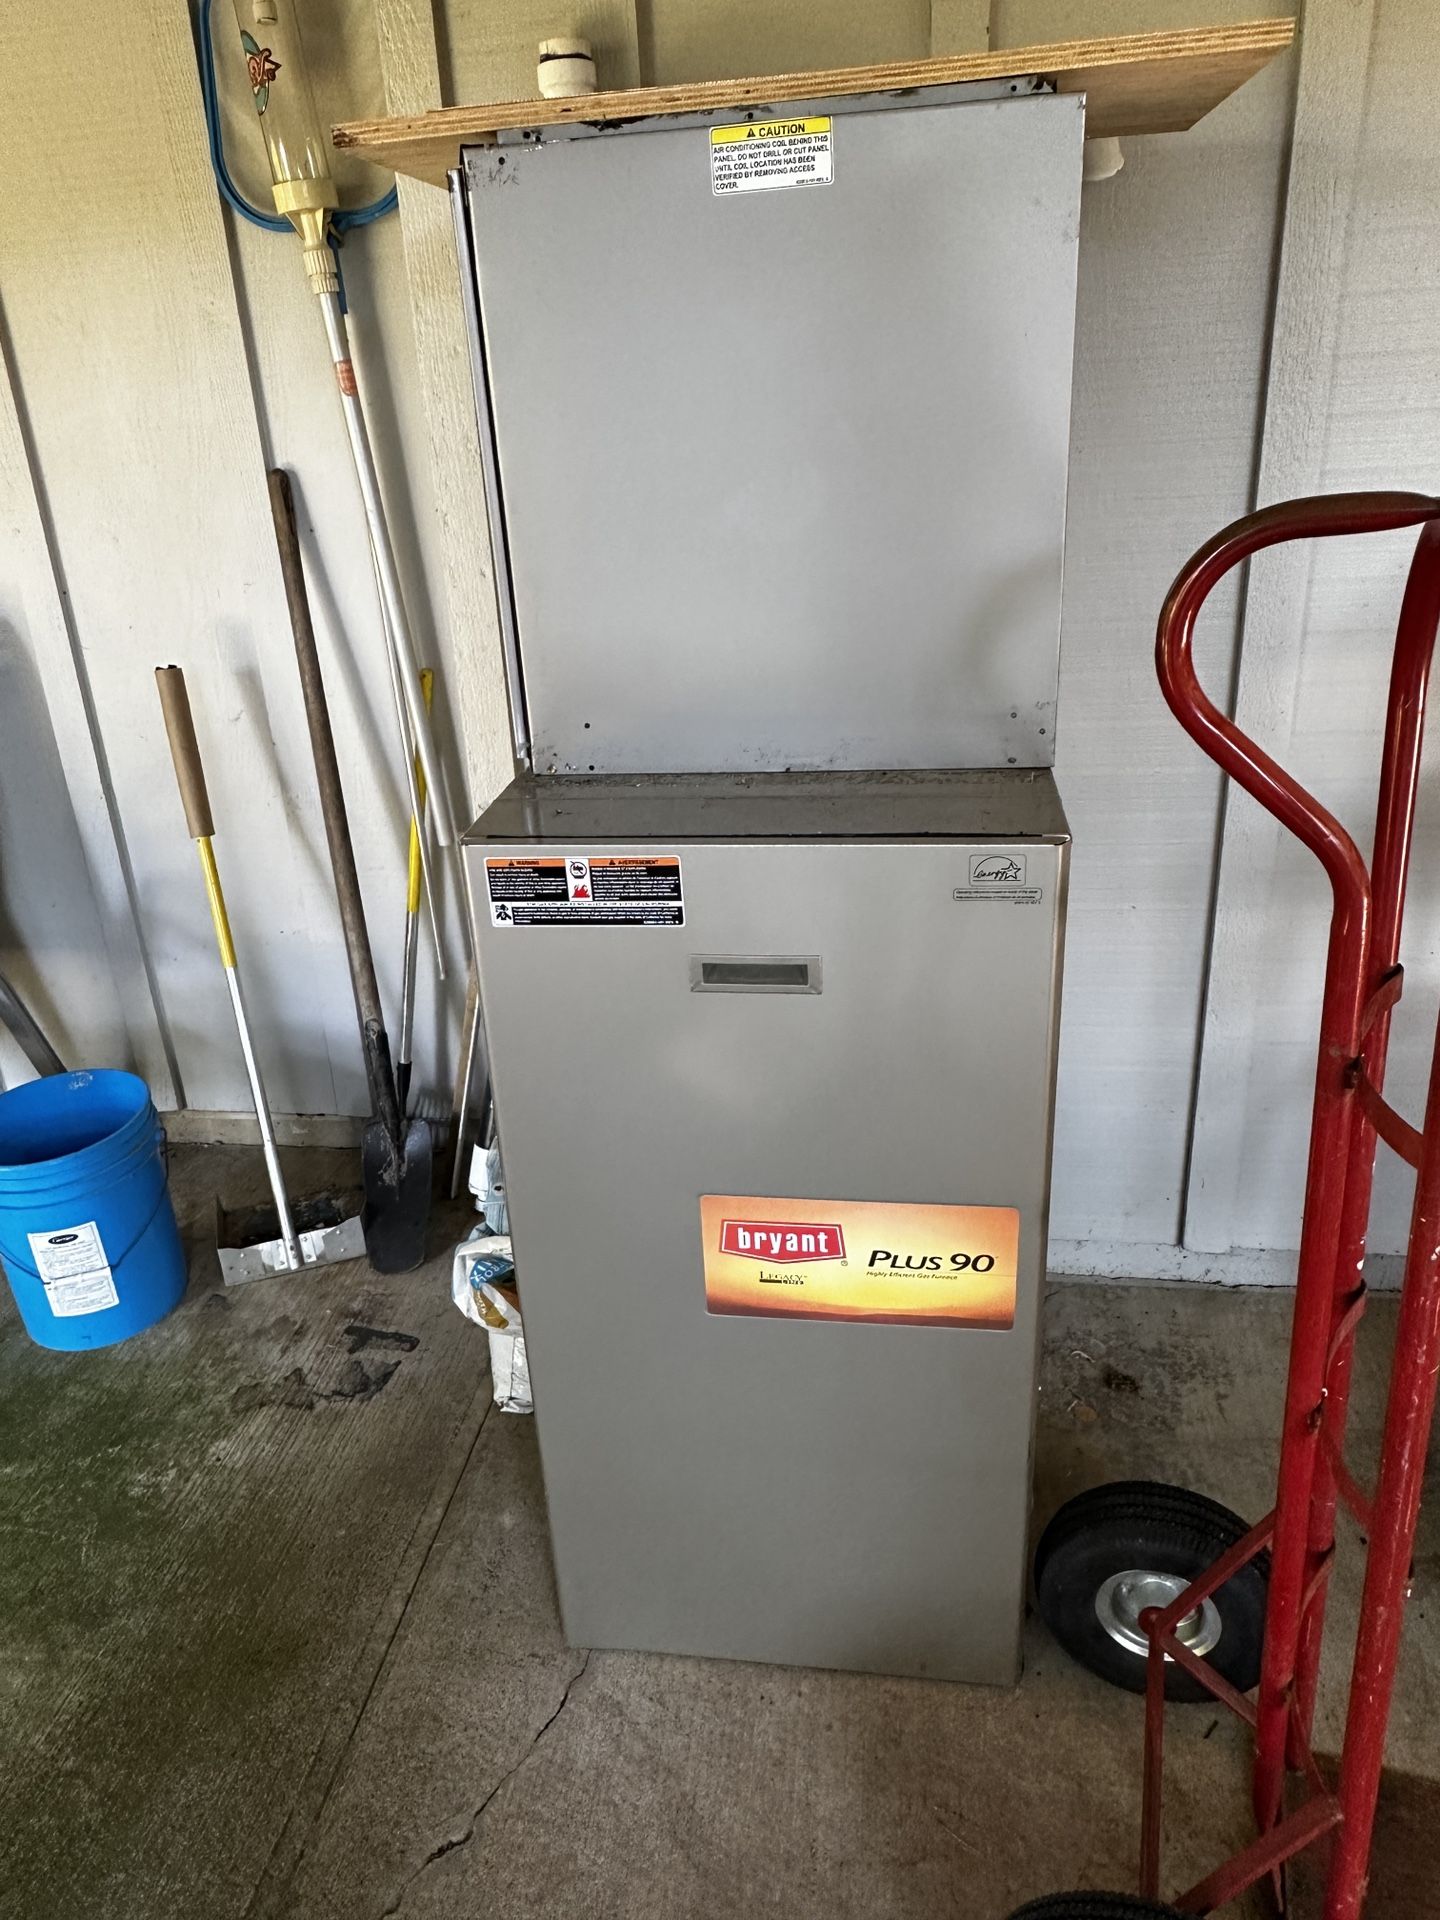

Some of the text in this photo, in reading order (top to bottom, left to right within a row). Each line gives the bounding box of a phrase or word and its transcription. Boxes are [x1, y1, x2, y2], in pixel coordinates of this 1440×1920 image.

[759, 124, 805, 137] CAUTION
[725, 142, 770, 153] CONDITIONING
[772, 139, 787, 147] COIL
[788, 137, 812, 147] BEHIND
[814, 135, 828, 143] THIS
[808, 144, 829, 153] PANEL
[714, 164, 732, 172] UNTIL
[751, 159, 782, 168] LOCATION
[798, 155, 815, 163] BEEN
[715, 172, 743, 181] VERIFIED
[754, 167, 787, 177] REMOVING
[789, 165, 815, 173] ACCESS
[737, 1227, 828, 1254] bryant
[868, 1250, 995, 1272] PLUS 90
